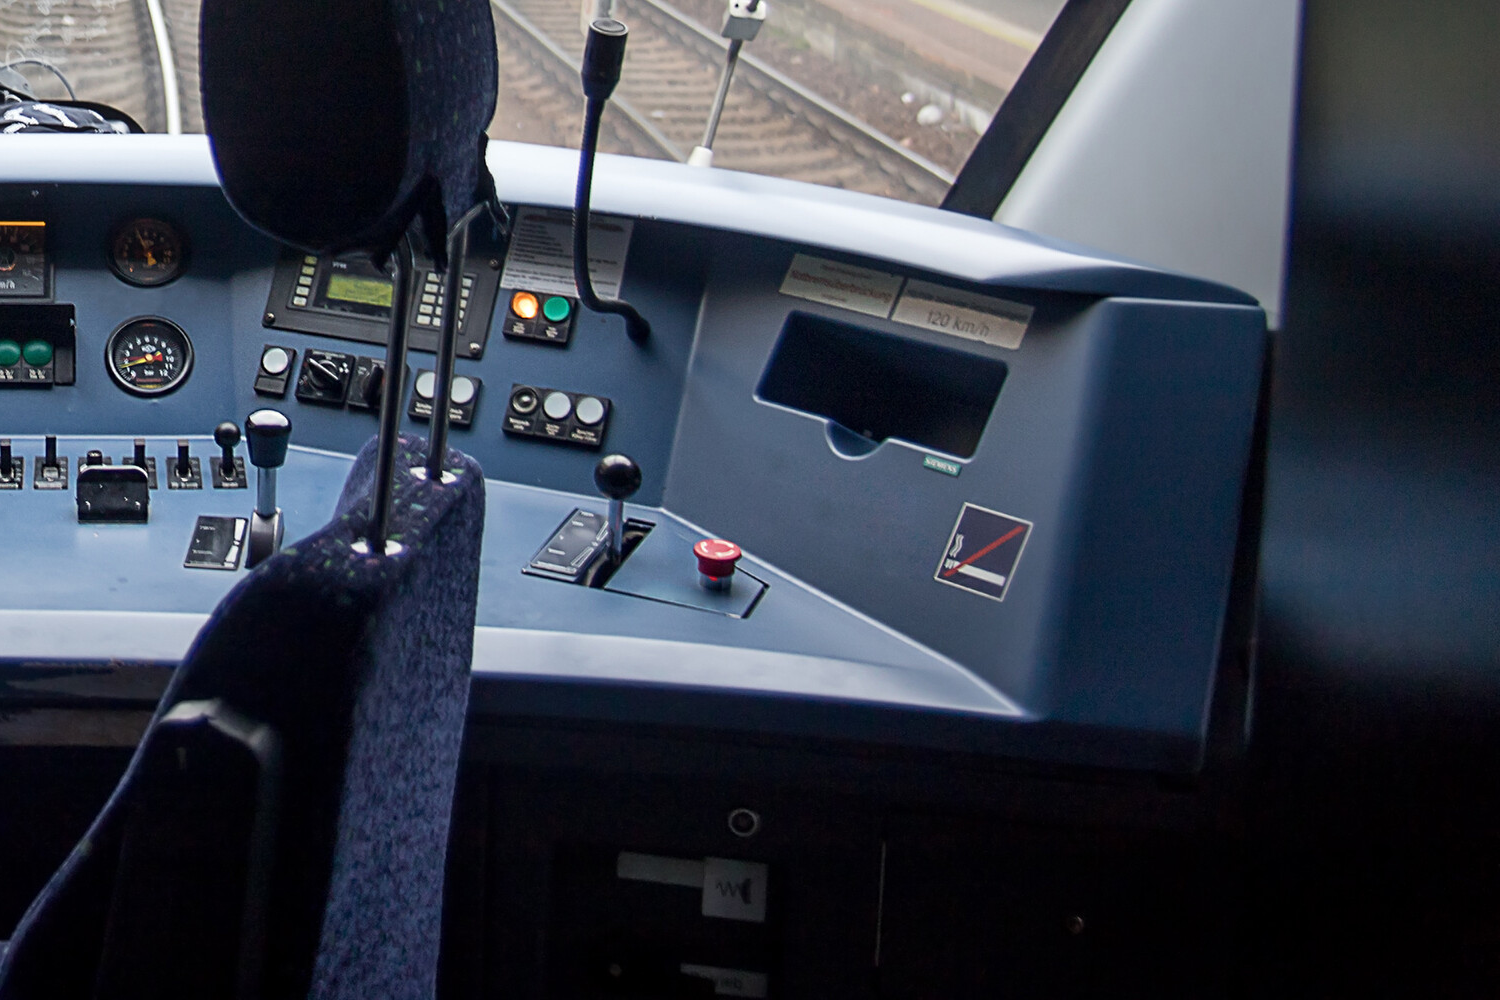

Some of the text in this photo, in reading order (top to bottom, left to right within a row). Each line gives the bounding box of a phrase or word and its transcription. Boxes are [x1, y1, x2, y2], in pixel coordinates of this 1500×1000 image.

[927, 310, 990, 338] 120 km/h
[925, 456, 958, 474] SIEMENS
